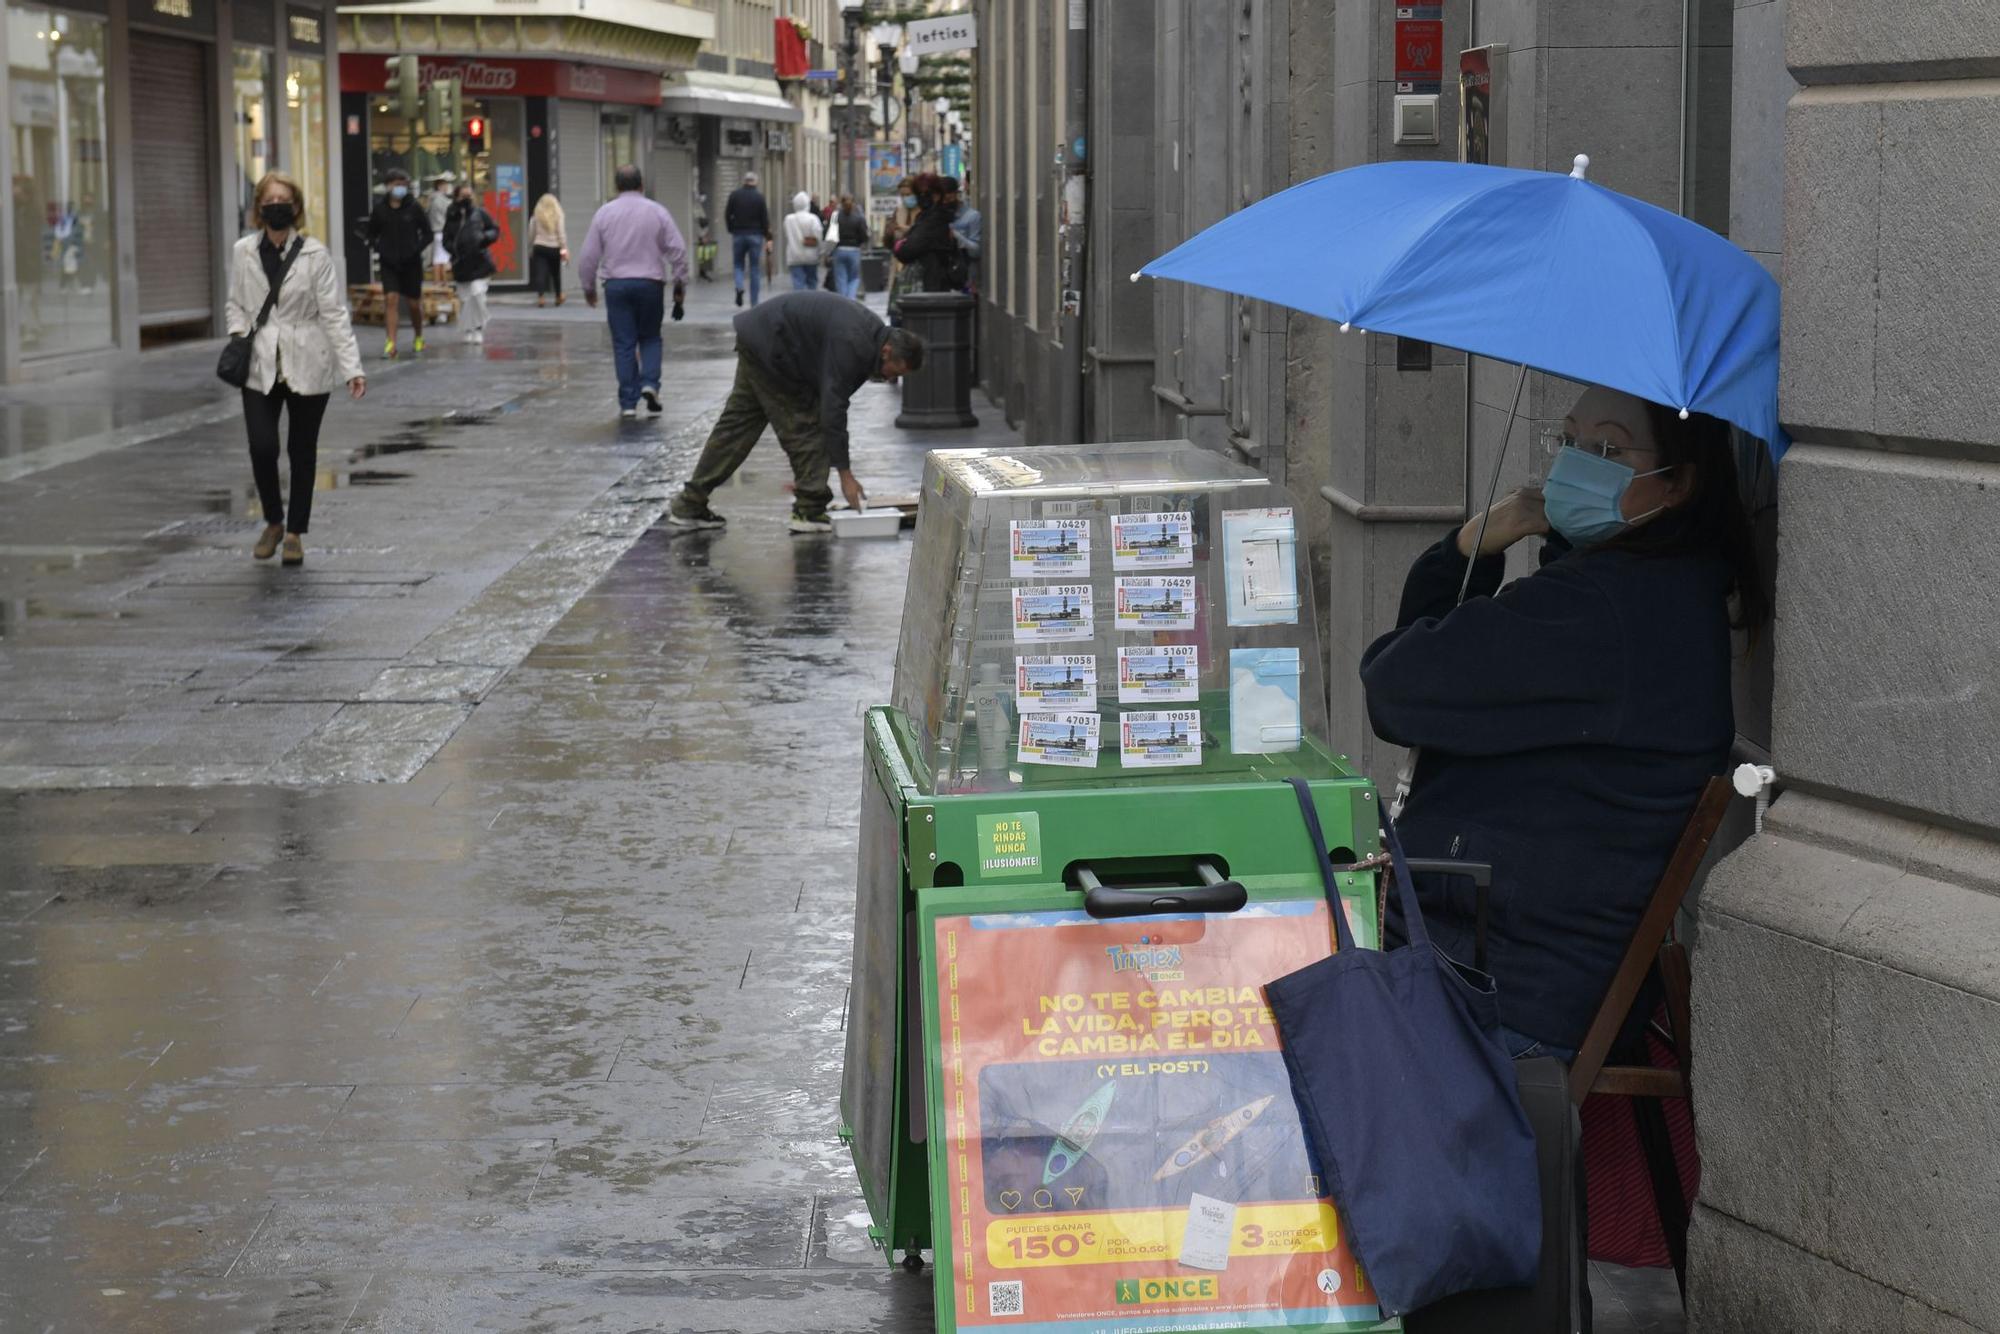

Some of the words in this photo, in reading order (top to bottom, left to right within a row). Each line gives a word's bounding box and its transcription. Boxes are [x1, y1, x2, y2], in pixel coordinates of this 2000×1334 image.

[916, 27, 968, 44] lefties
[466, 62, 516, 89] Mars
[1157, 513, 1187, 522] 89746
[1056, 520, 1086, 529] 76429
[1161, 578, 1191, 587] 76429
[1058, 586, 1088, 595] 39870
[1163, 647, 1193, 655] 51607
[1063, 656, 1092, 664] 19058
[1066, 716, 1096, 725] 47031
[1167, 712, 1196, 720] 19058
[995, 822, 1009, 832] NO
[1011, 821, 1023, 831] TE
[993, 831, 1026, 843] RINDAS
[995, 842, 1026, 854] NUNCA
[983, 855, 1039, 870] ¡ILUSIÓNATE!
[1106, 944, 1184, 972] Triplex
[1040, 993, 1085, 1013] NO
[1091, 992, 1130, 1011] TE
[1137, 986, 1258, 1009] CAMBIA
[1023, 1018, 1062, 1036] LA
[1066, 1013, 1145, 1034] VIDA,
[1151, 1008, 1234, 1029] PERO
[1238, 1007, 1277, 1025] TE
[1038, 1034, 1160, 1056] CAMBIA
[1167, 1031, 1205, 1050] EL
[1212, 1026, 1264, 1048] DÍA
[1097, 1063, 1117, 1078] (Y
[1121, 1063, 1144, 1076] EL
[1149, 1060, 1209, 1075] POST)
[1006, 1225, 1050, 1235] PUEDES
[1052, 1222, 1092, 1232] GANAR
[1267, 1228, 1318, 1238] SORTEOS
[1241, 1224, 1265, 1248] 3
[1007, 1231, 1096, 1260] 150€
[1107, 1238, 1130, 1246] POR
[1267, 1239, 1281, 1247] AL
[1107, 1246, 1136, 1255] SOLO
[1144, 1279, 1213, 1298] ONCE
[1056, 1311, 1095, 1319] Vendedores
[1096, 1310, 1118, 1318] ONCE,
[1119, 1309, 1141, 1317] puntos
